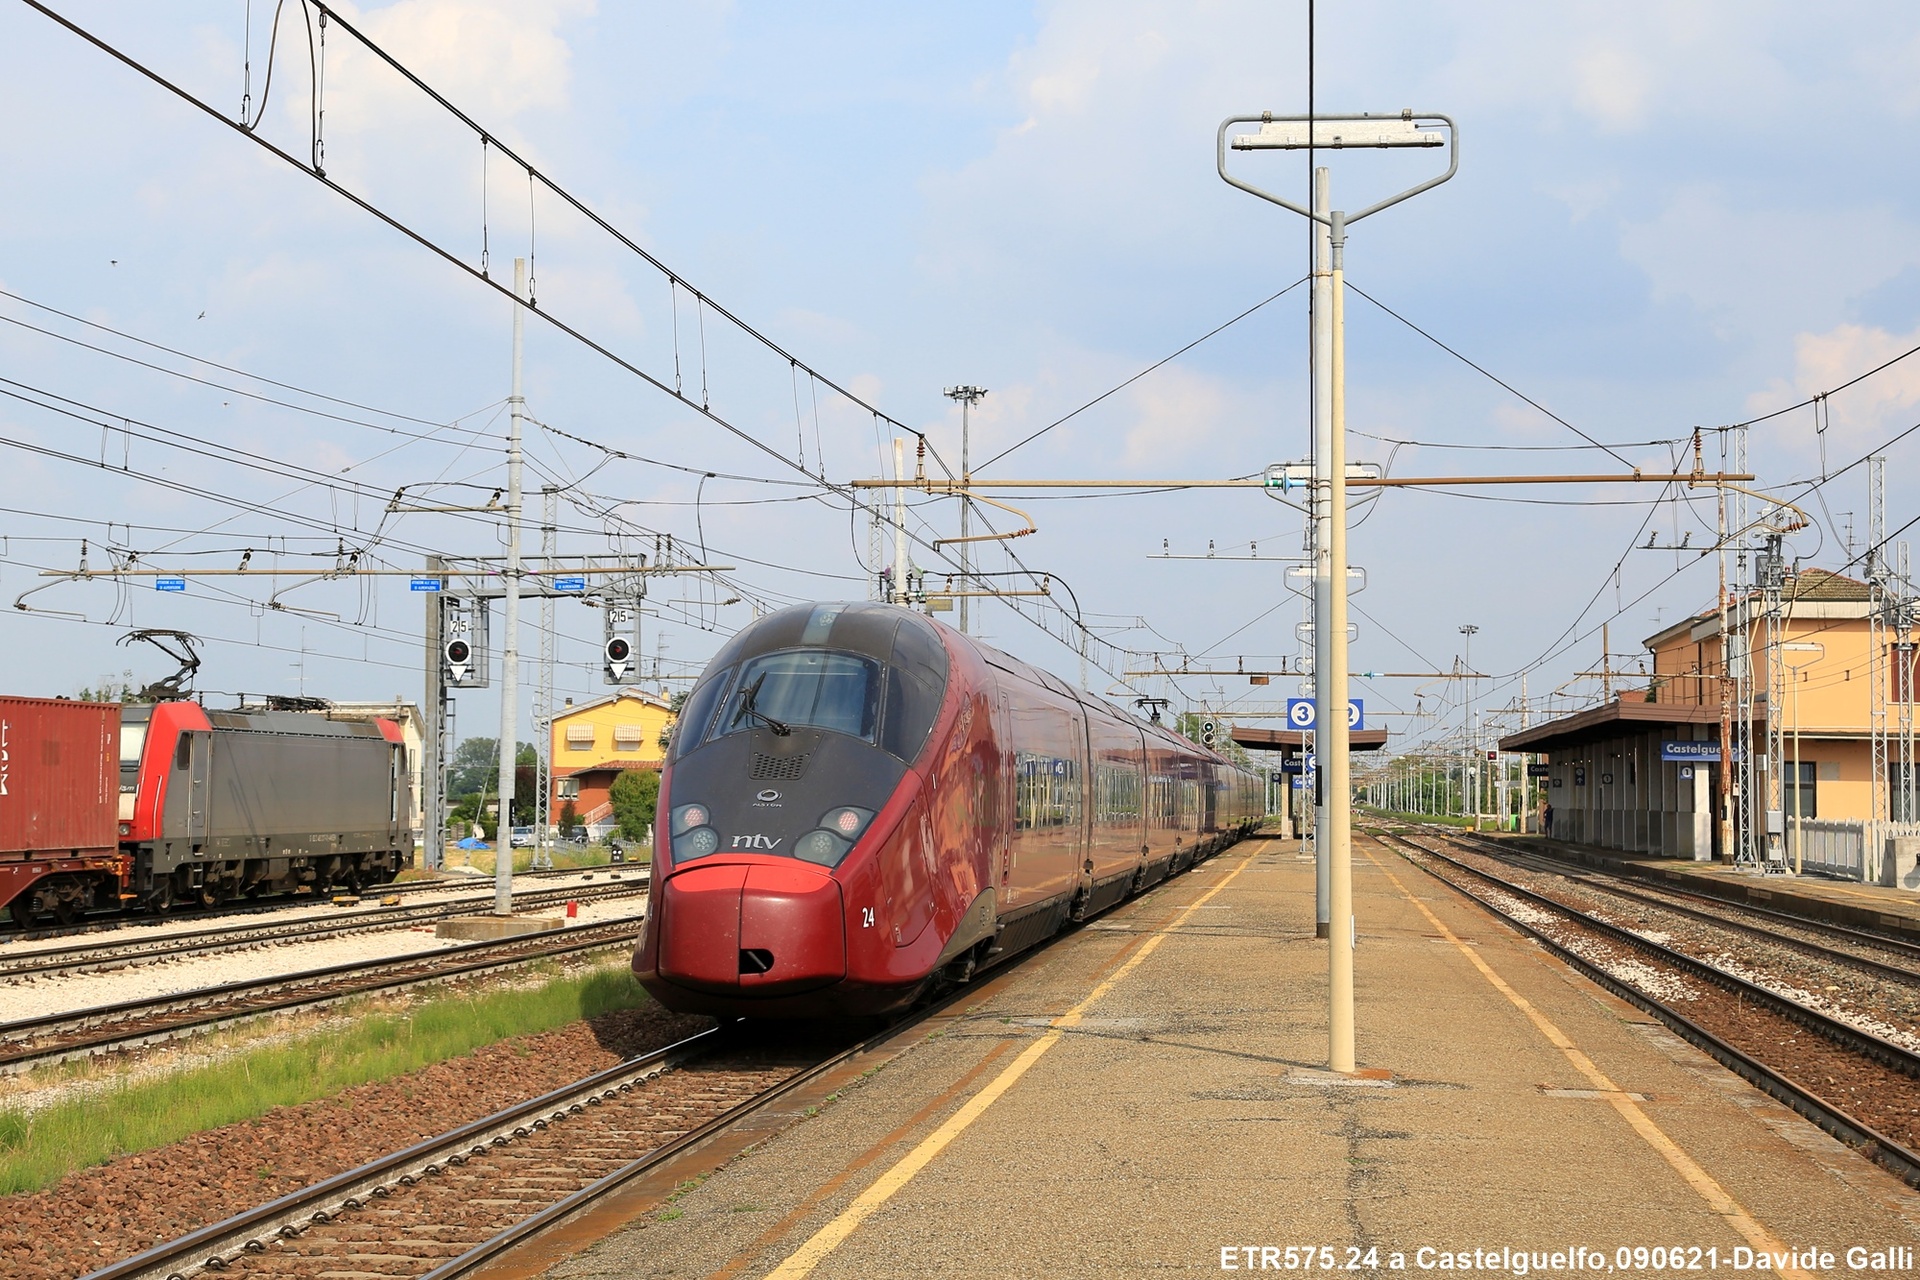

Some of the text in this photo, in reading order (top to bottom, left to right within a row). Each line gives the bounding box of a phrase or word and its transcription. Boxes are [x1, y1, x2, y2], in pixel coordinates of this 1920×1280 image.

[611, 610, 627, 623] 215
[452, 620, 467, 633] 215
[1297, 705, 1309, 722] 3
[731, 833, 782, 850] ntv
[862, 906, 875, 928] 24
